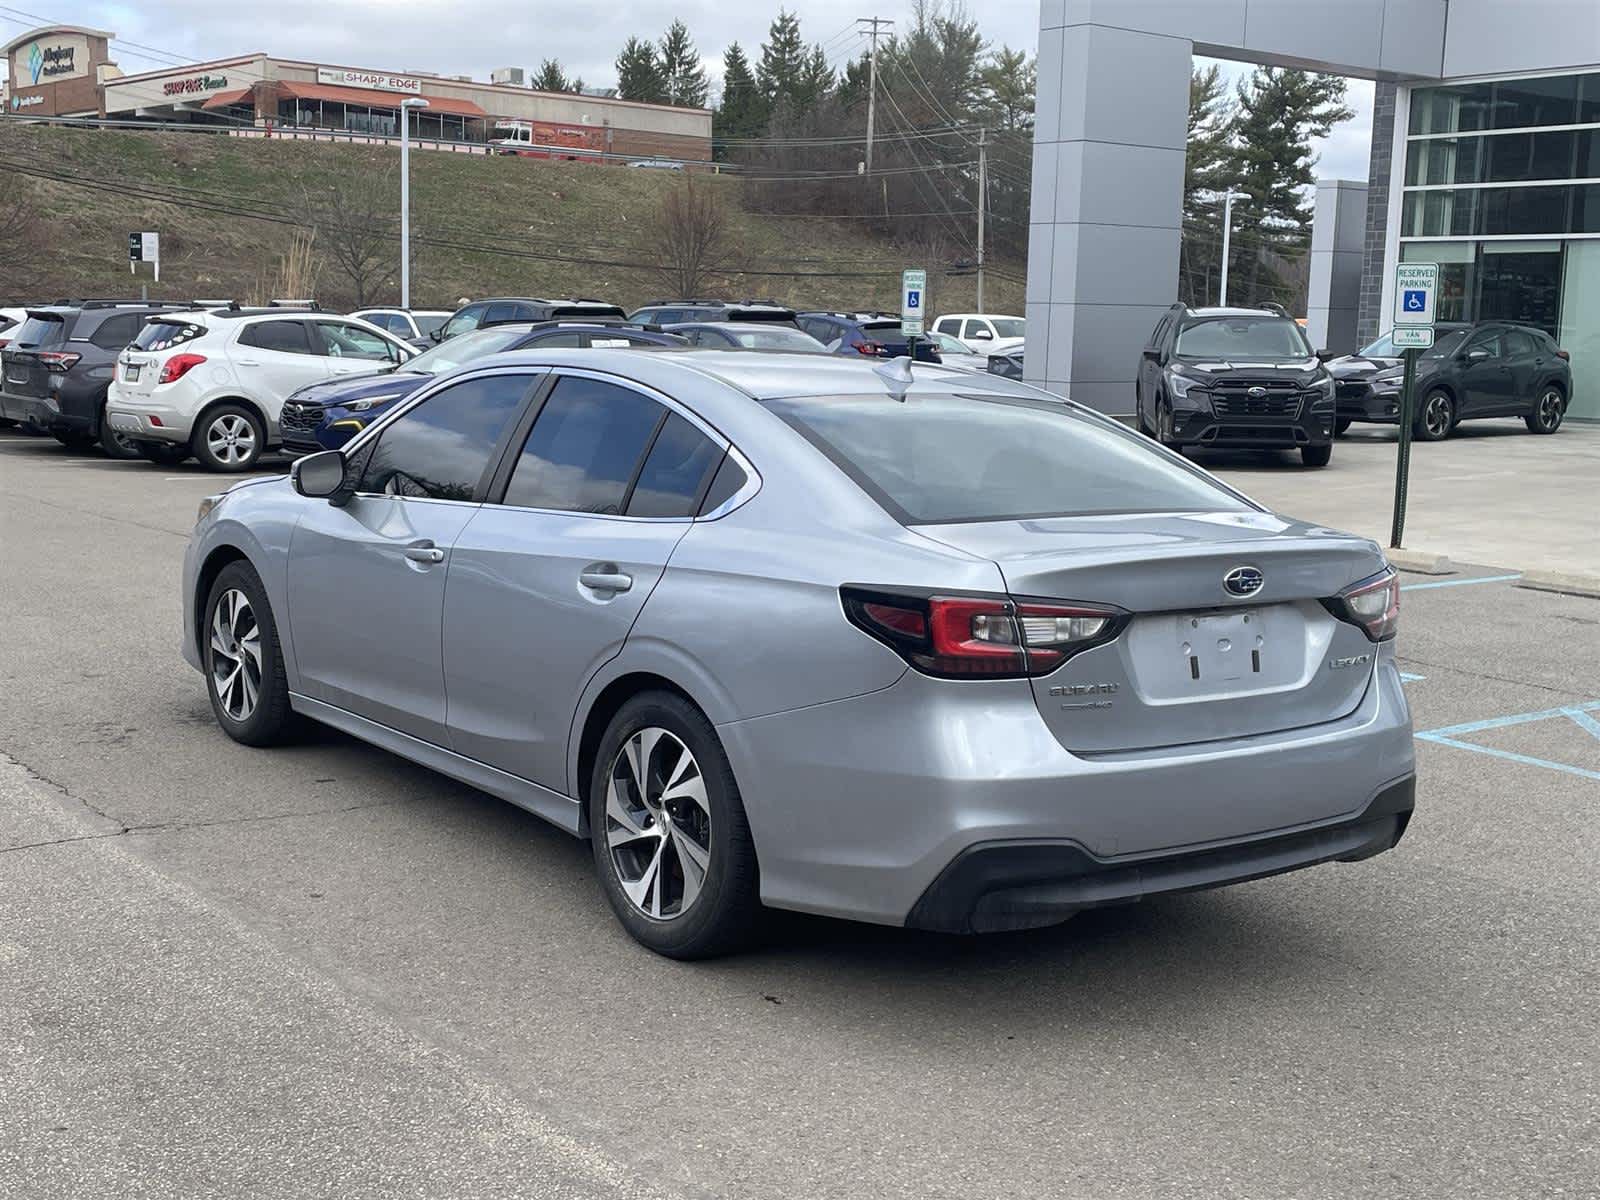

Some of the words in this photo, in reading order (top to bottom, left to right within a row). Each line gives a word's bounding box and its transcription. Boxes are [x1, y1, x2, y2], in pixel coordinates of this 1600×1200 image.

[345, 73, 385, 85] SHARP
[388, 78, 419, 90] EDGE
[1399, 269, 1435, 278] RESERVED
[1400, 279, 1432, 288] PARKING
[1048, 683, 1120, 697] SUBARU
